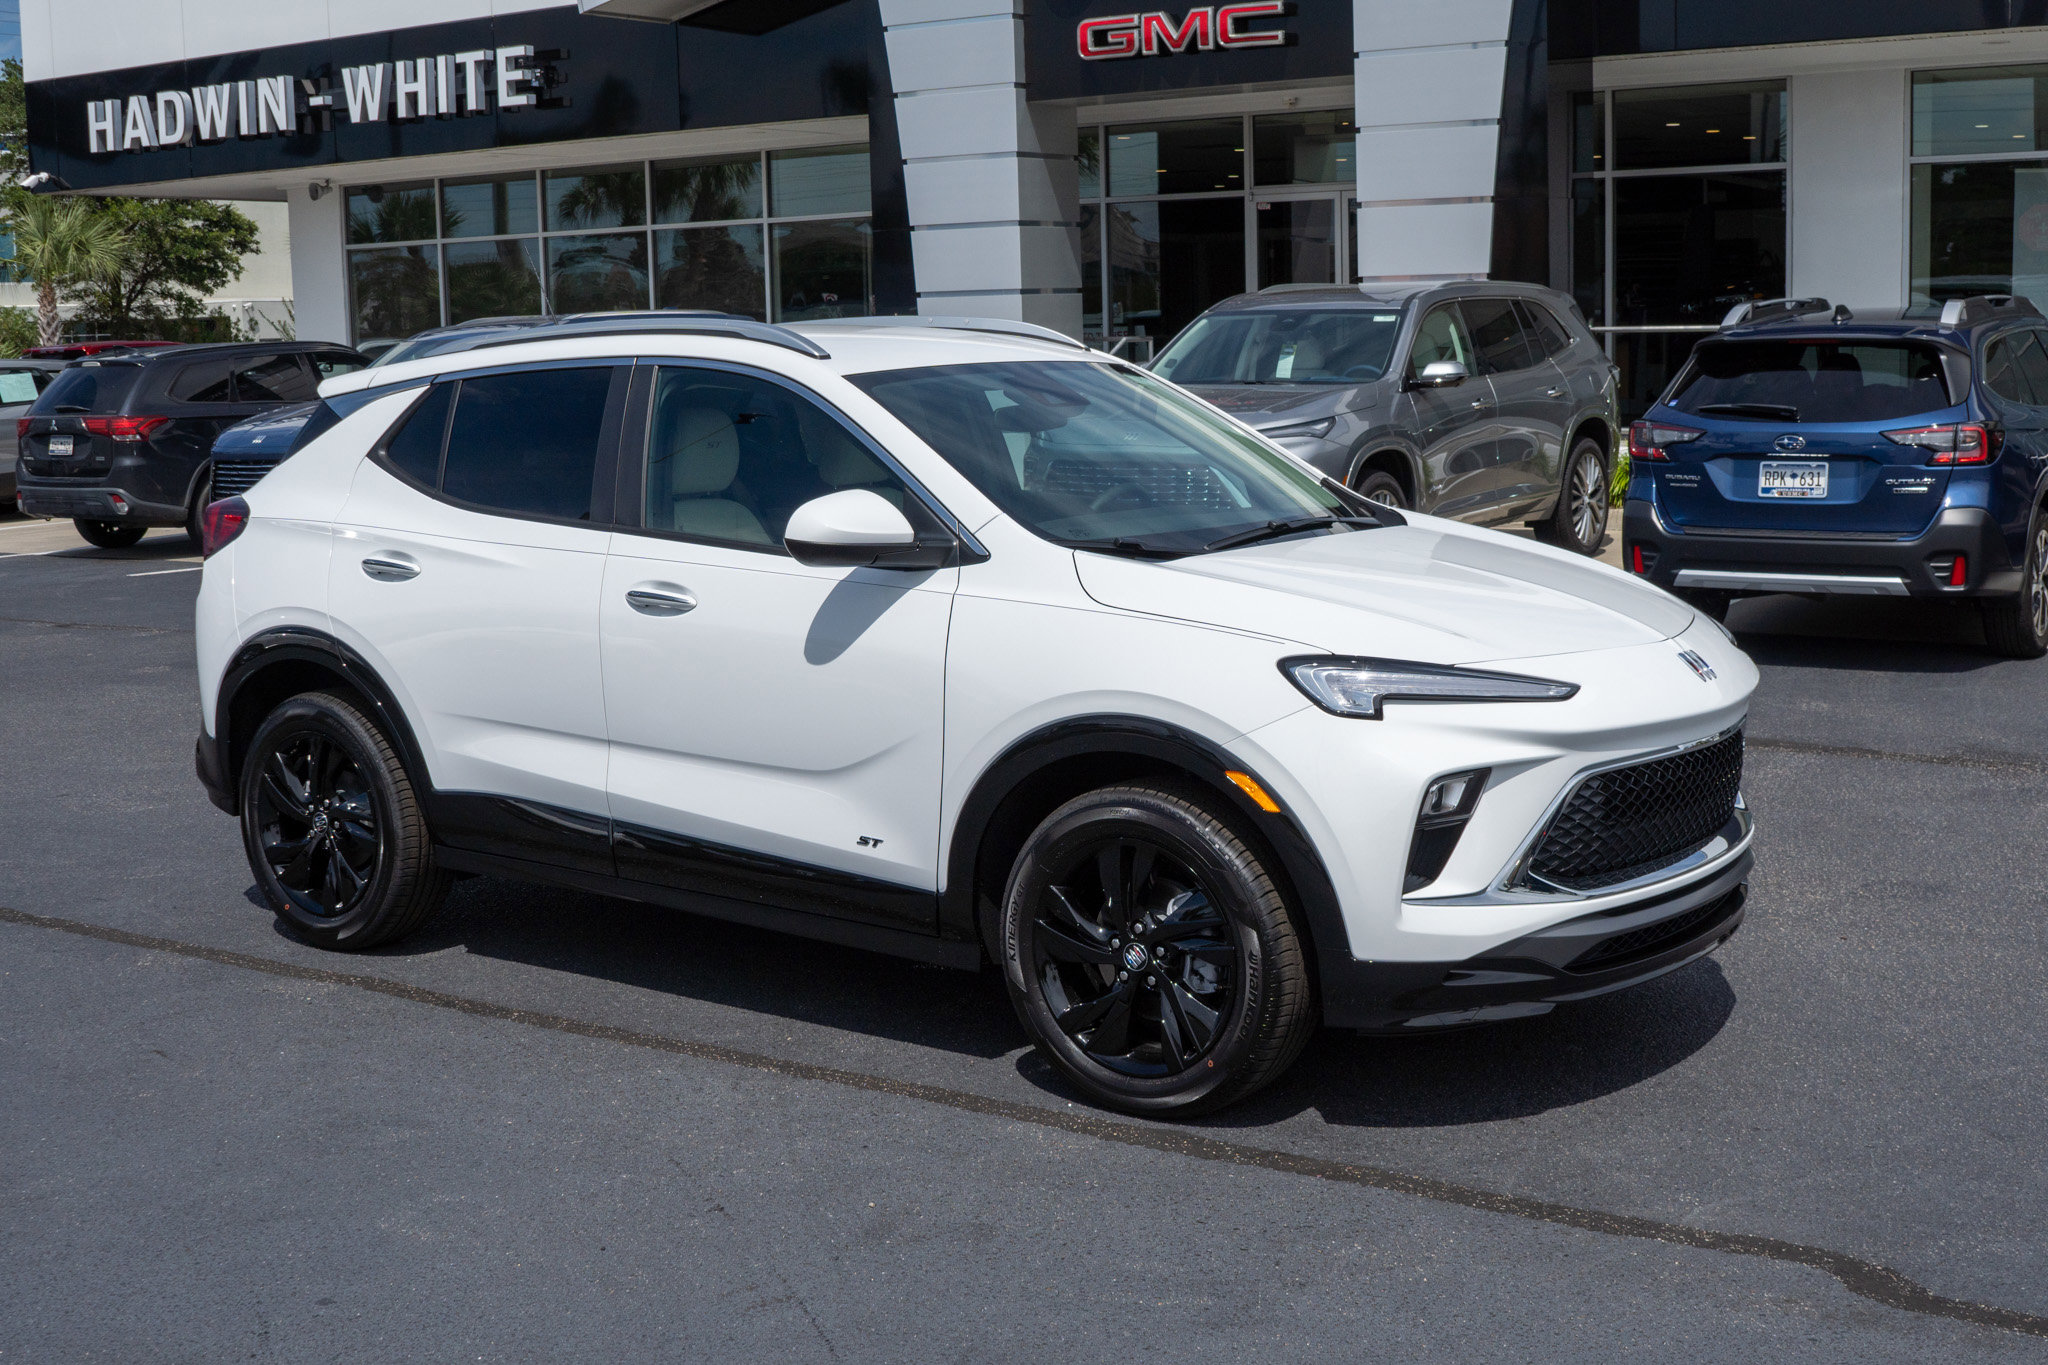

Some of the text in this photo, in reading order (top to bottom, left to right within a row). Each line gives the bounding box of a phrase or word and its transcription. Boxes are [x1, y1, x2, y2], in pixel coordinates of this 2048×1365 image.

[1077, 1, 1285, 60] GMC
[1764, 470, 1822, 487] RPK 631
[856, 835, 884, 848] ST
